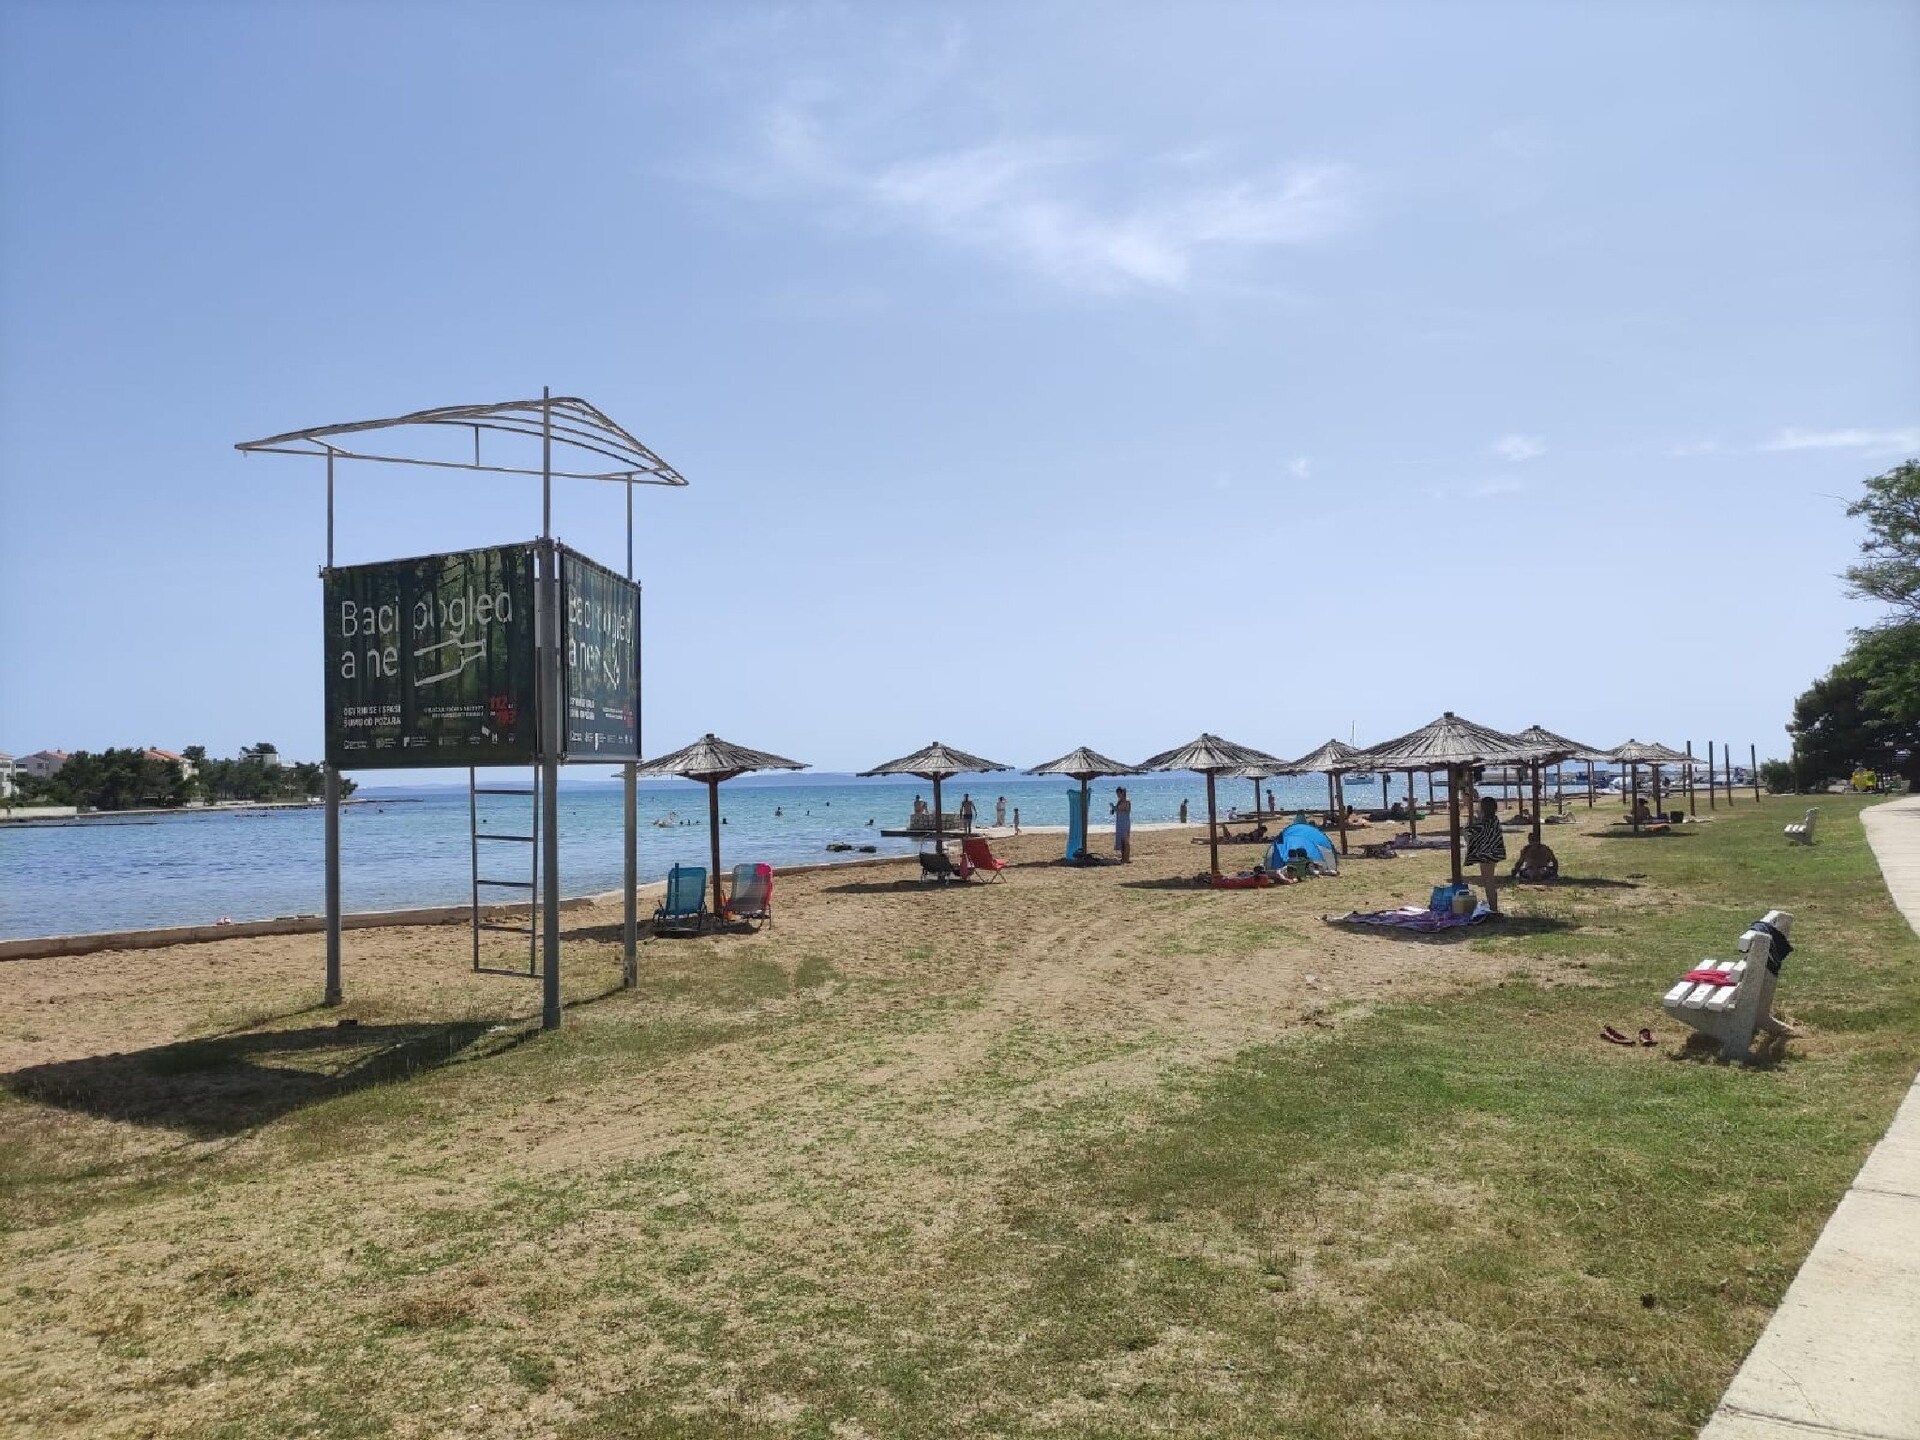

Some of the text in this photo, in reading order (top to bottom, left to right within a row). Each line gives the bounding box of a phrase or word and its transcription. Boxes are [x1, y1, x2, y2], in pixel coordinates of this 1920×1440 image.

[341, 595, 399, 637] Baci
[341, 646, 399, 679] a ne
